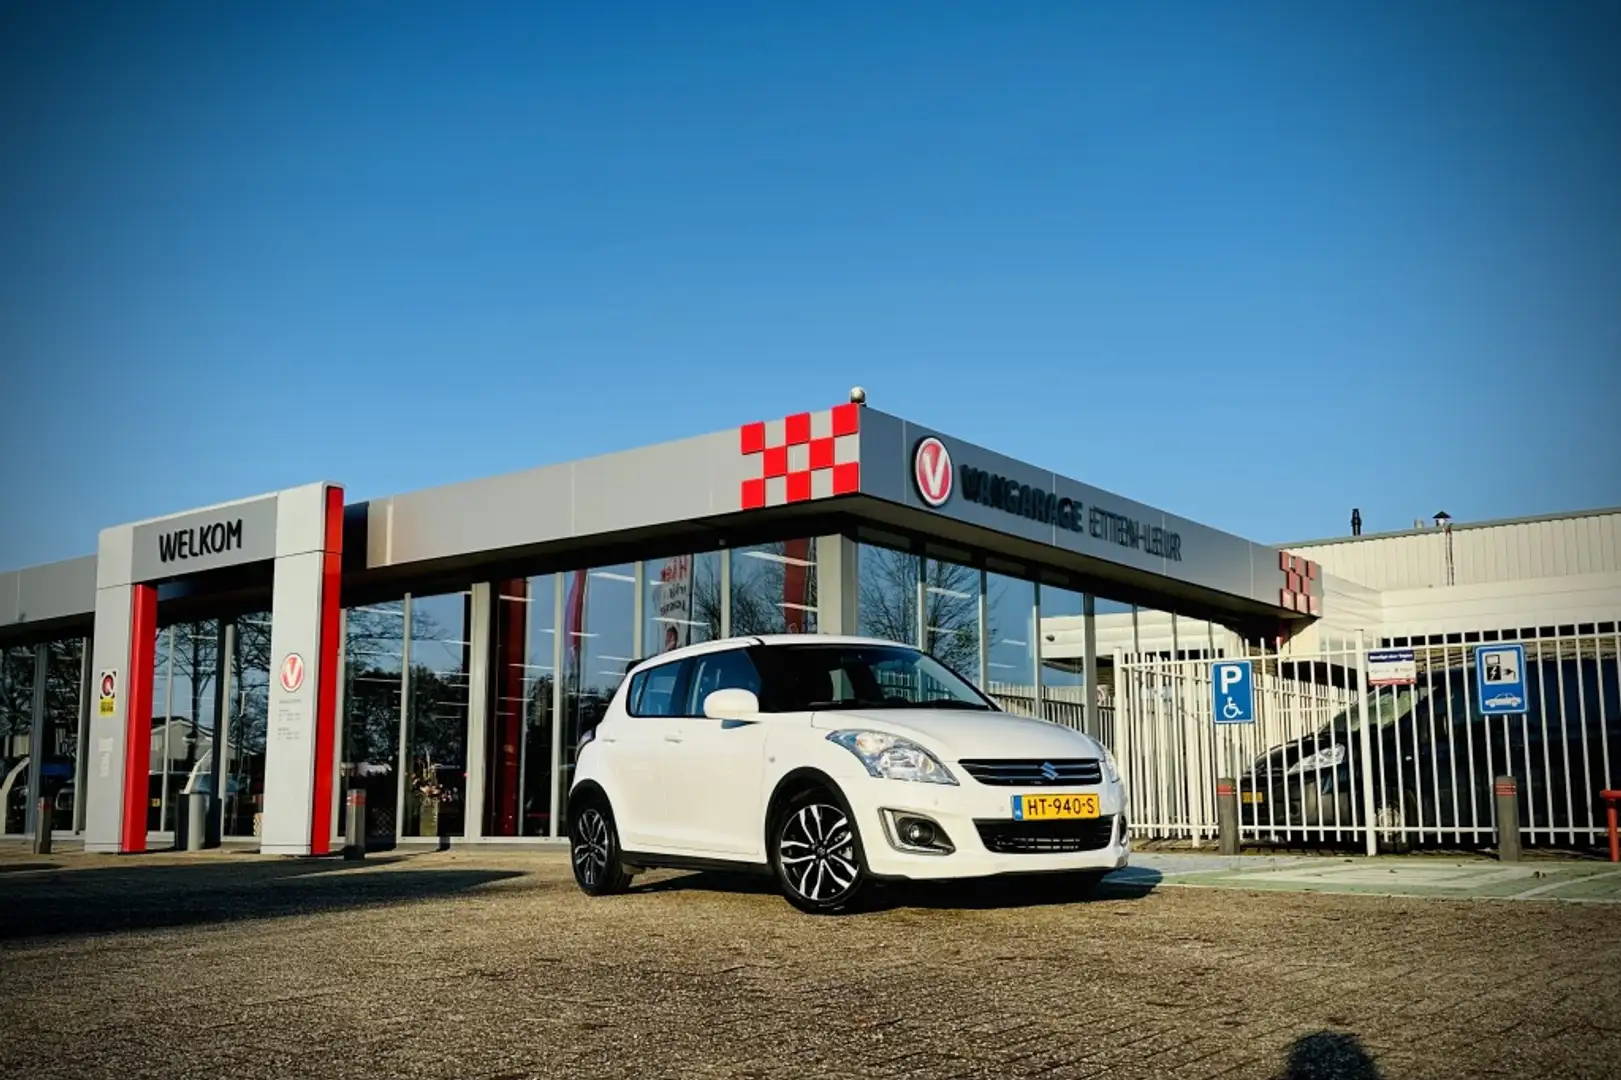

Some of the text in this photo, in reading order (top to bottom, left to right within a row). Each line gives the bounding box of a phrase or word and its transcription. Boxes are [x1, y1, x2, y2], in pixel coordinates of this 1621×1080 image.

[159, 518, 242, 563] WELKOM
[1221, 666, 1242, 694] P
[1028, 798, 1095, 816] HT-940-S
